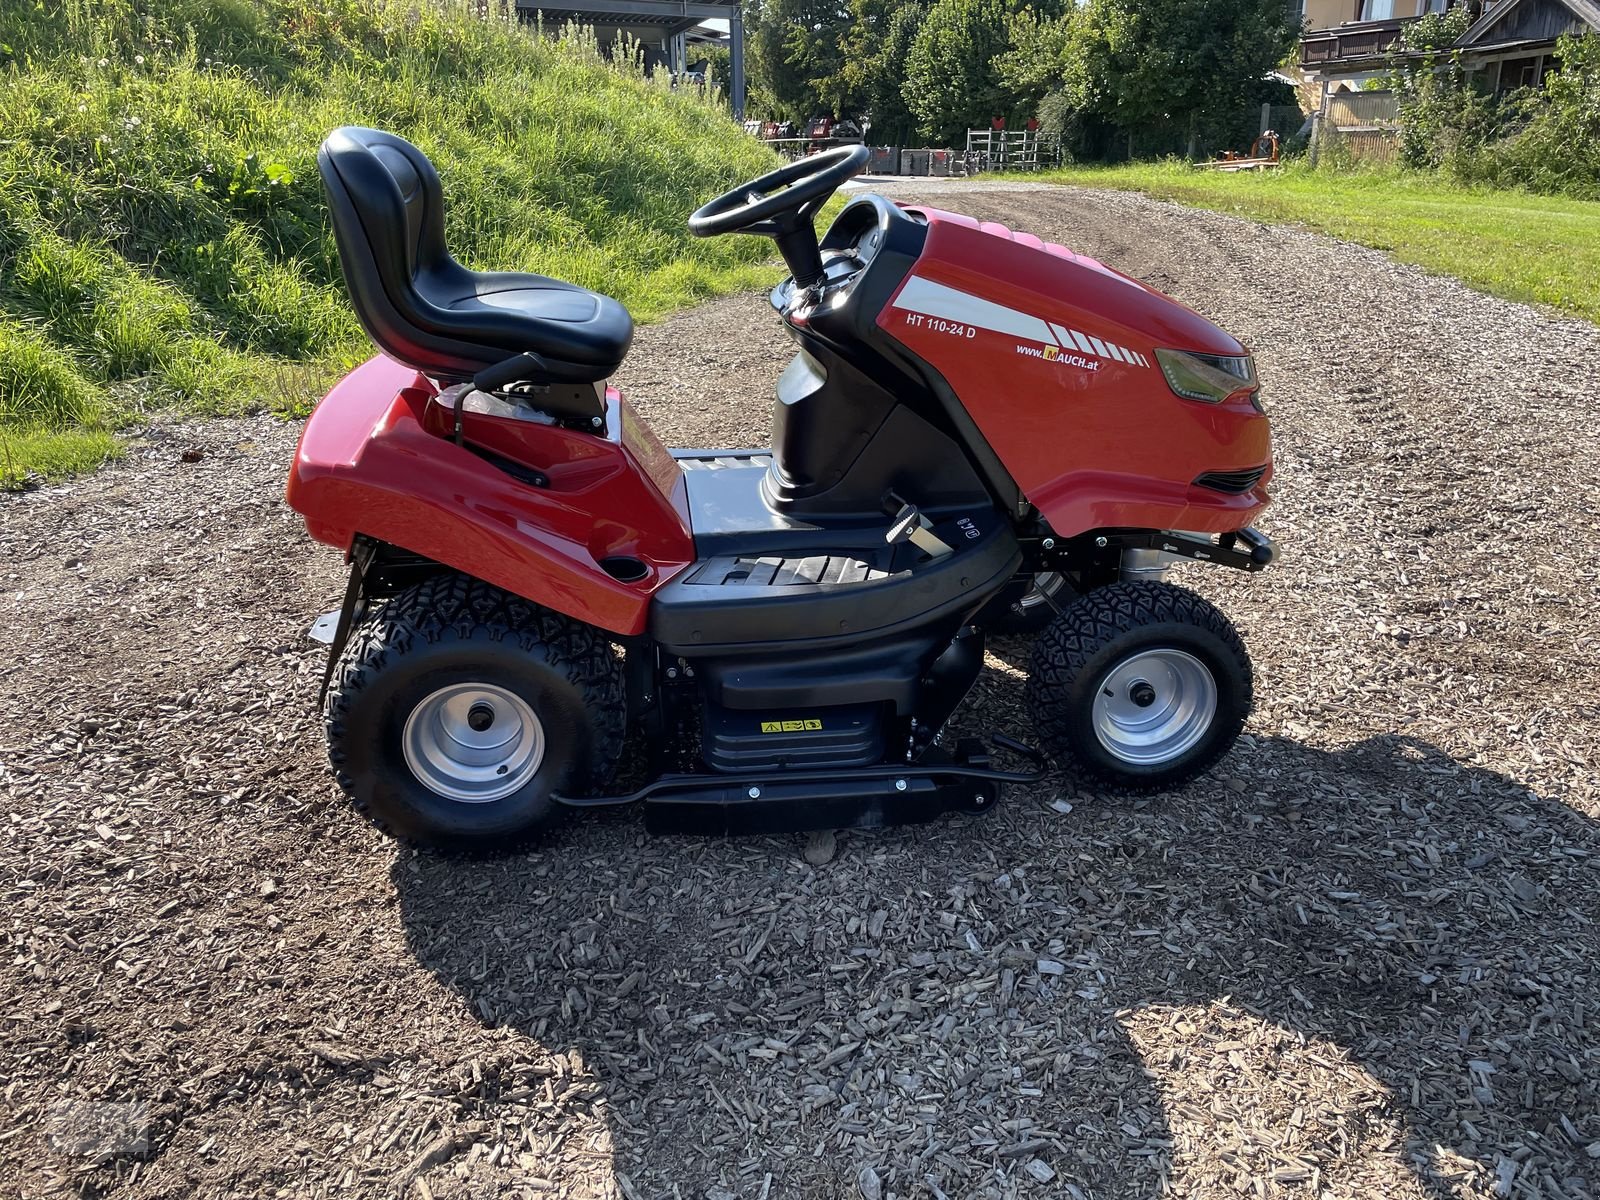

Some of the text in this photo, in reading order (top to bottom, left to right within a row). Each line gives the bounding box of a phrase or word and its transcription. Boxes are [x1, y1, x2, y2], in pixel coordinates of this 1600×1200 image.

[906, 313, 977, 339] HT 110-24 D
[1016, 344, 1099, 371] www.MAUCH.at
